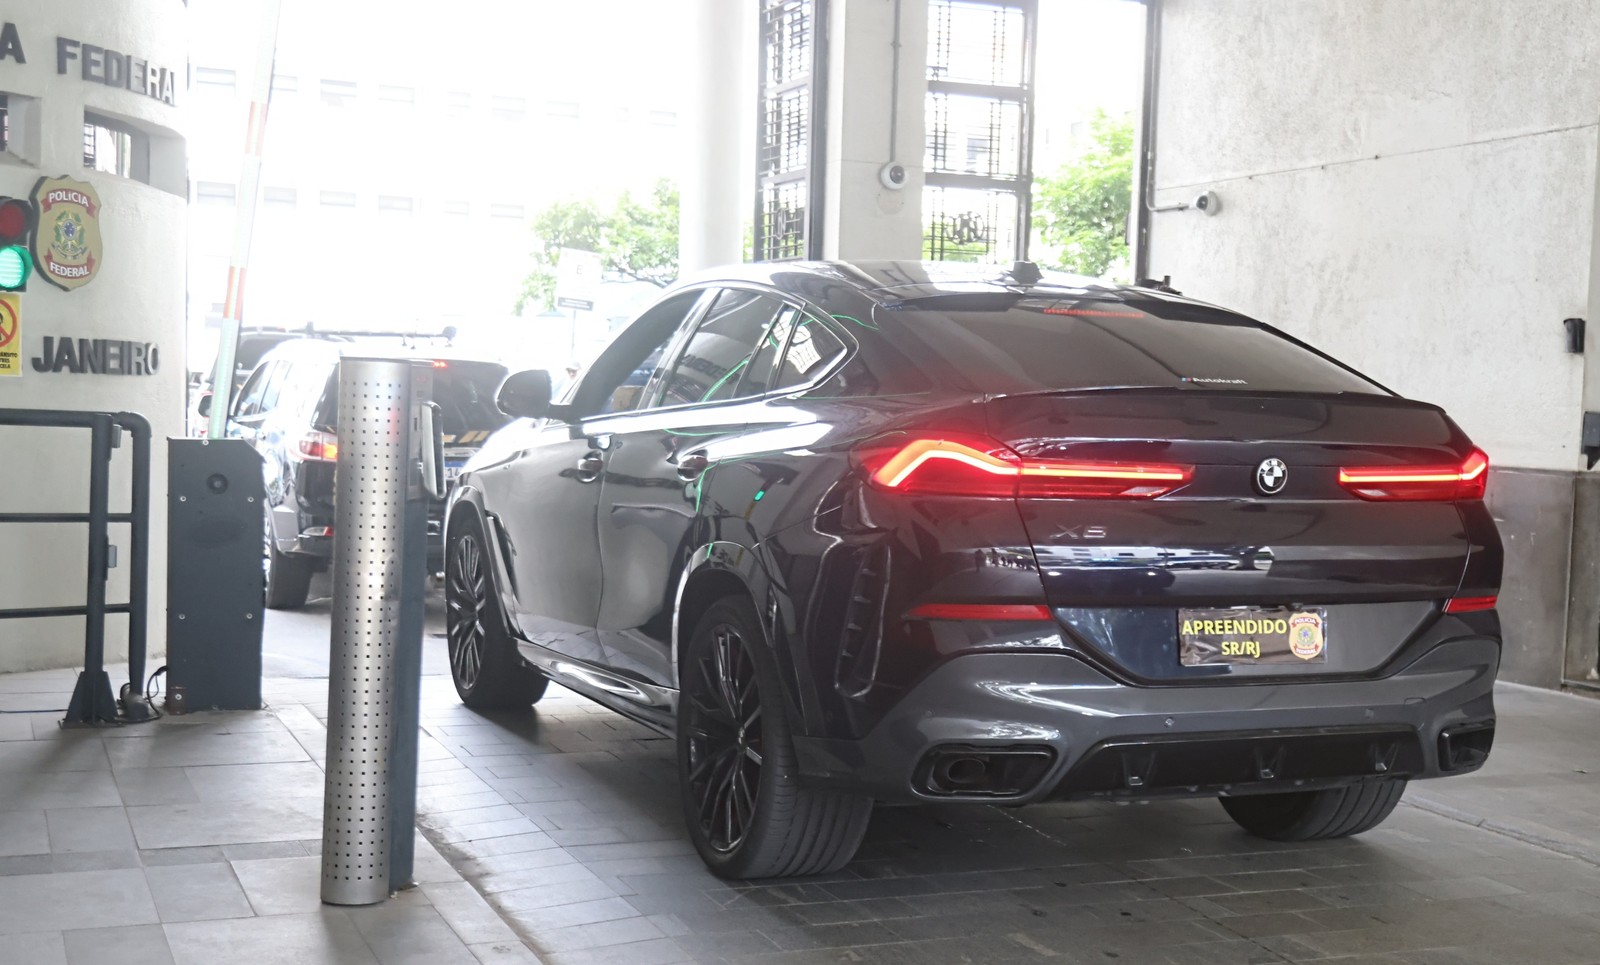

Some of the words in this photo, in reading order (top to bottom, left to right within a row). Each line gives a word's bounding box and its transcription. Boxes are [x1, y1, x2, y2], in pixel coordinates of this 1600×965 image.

[50, 262, 90, 277] FEDERAL
[31, 336, 160, 376] JANEIRO
[1192, 377, 1248, 385] Autokraft
[1049, 523, 1107, 539] X6
[1182, 619, 1287, 635] APREENDIDO
[1221, 641, 1261, 659] SR/RJ
[1295, 647, 1316, 655] FEDERAL
